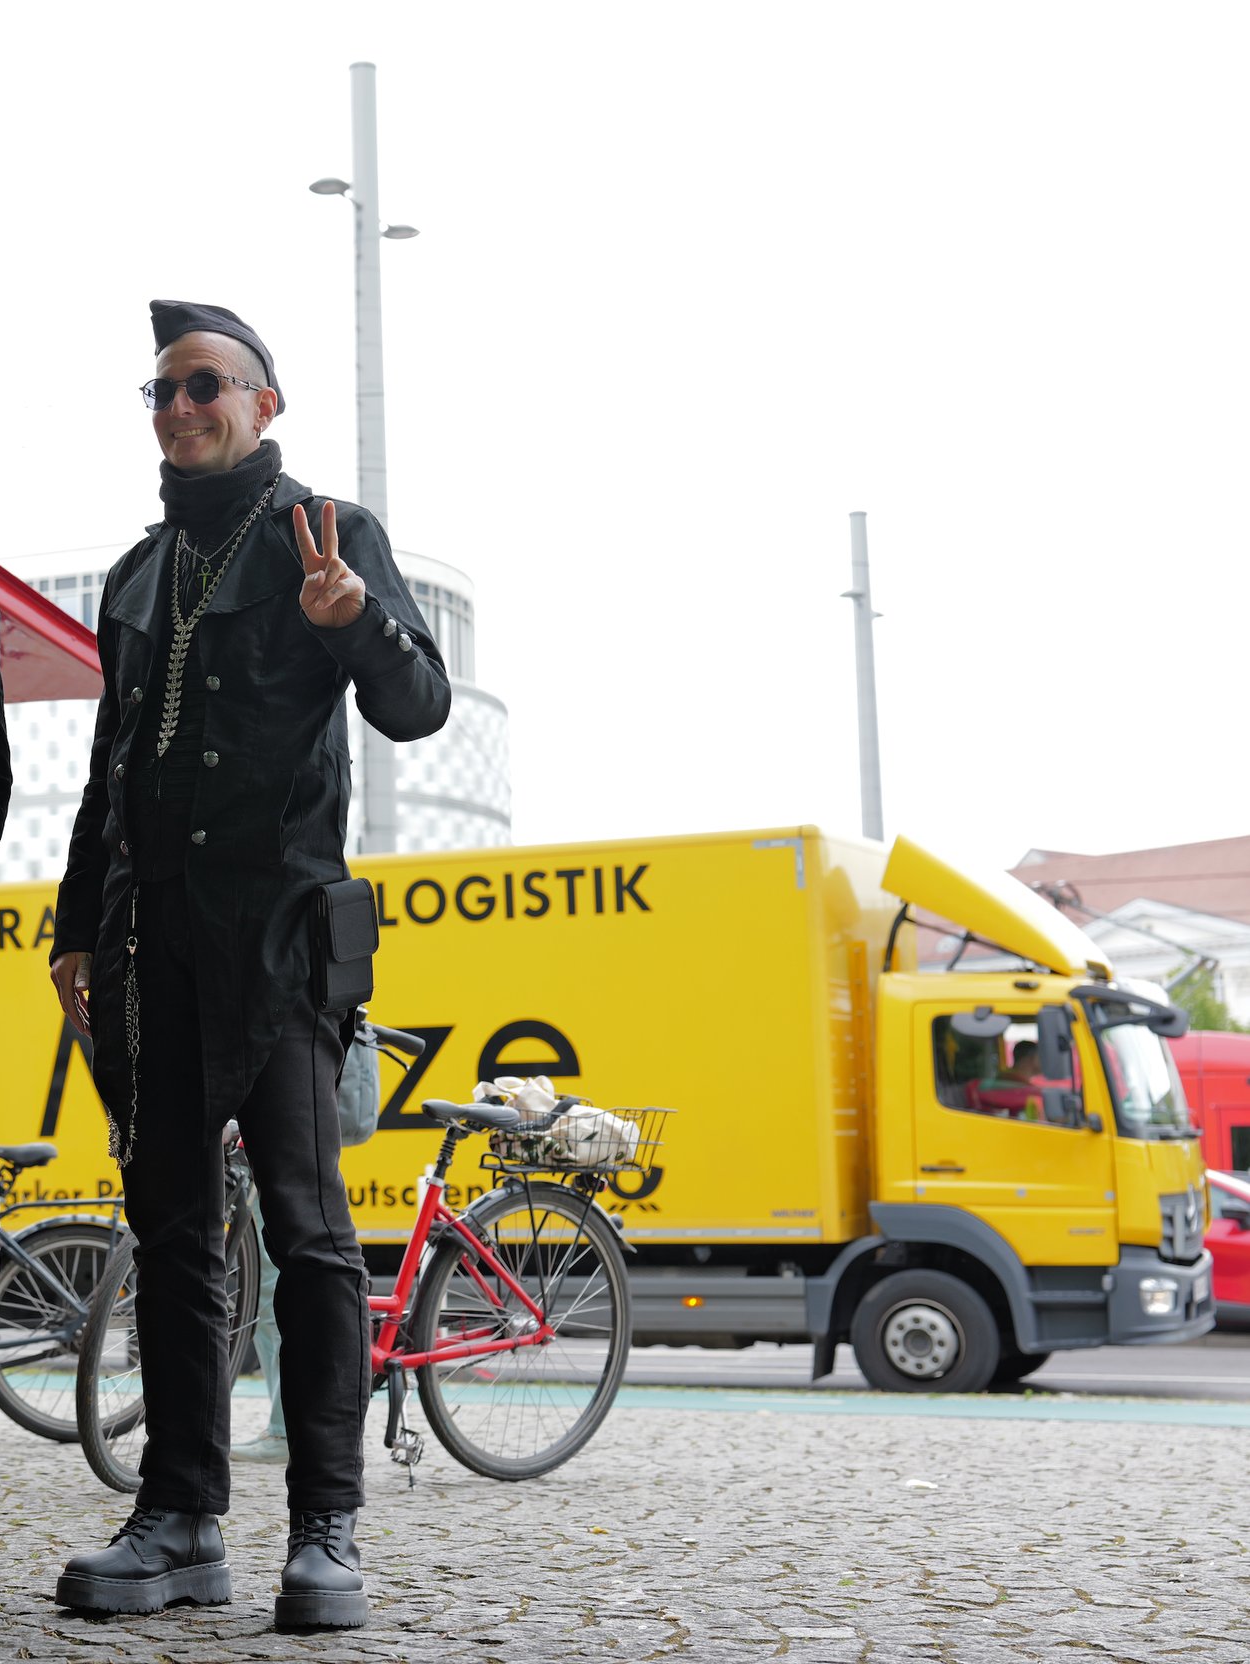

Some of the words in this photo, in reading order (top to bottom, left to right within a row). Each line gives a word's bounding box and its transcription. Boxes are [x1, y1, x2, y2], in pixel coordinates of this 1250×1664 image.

[376, 863, 652, 928] LOGISTIK
[4, 1179, 83, 1209] arker
[347, 1180, 487, 1207] utscen
